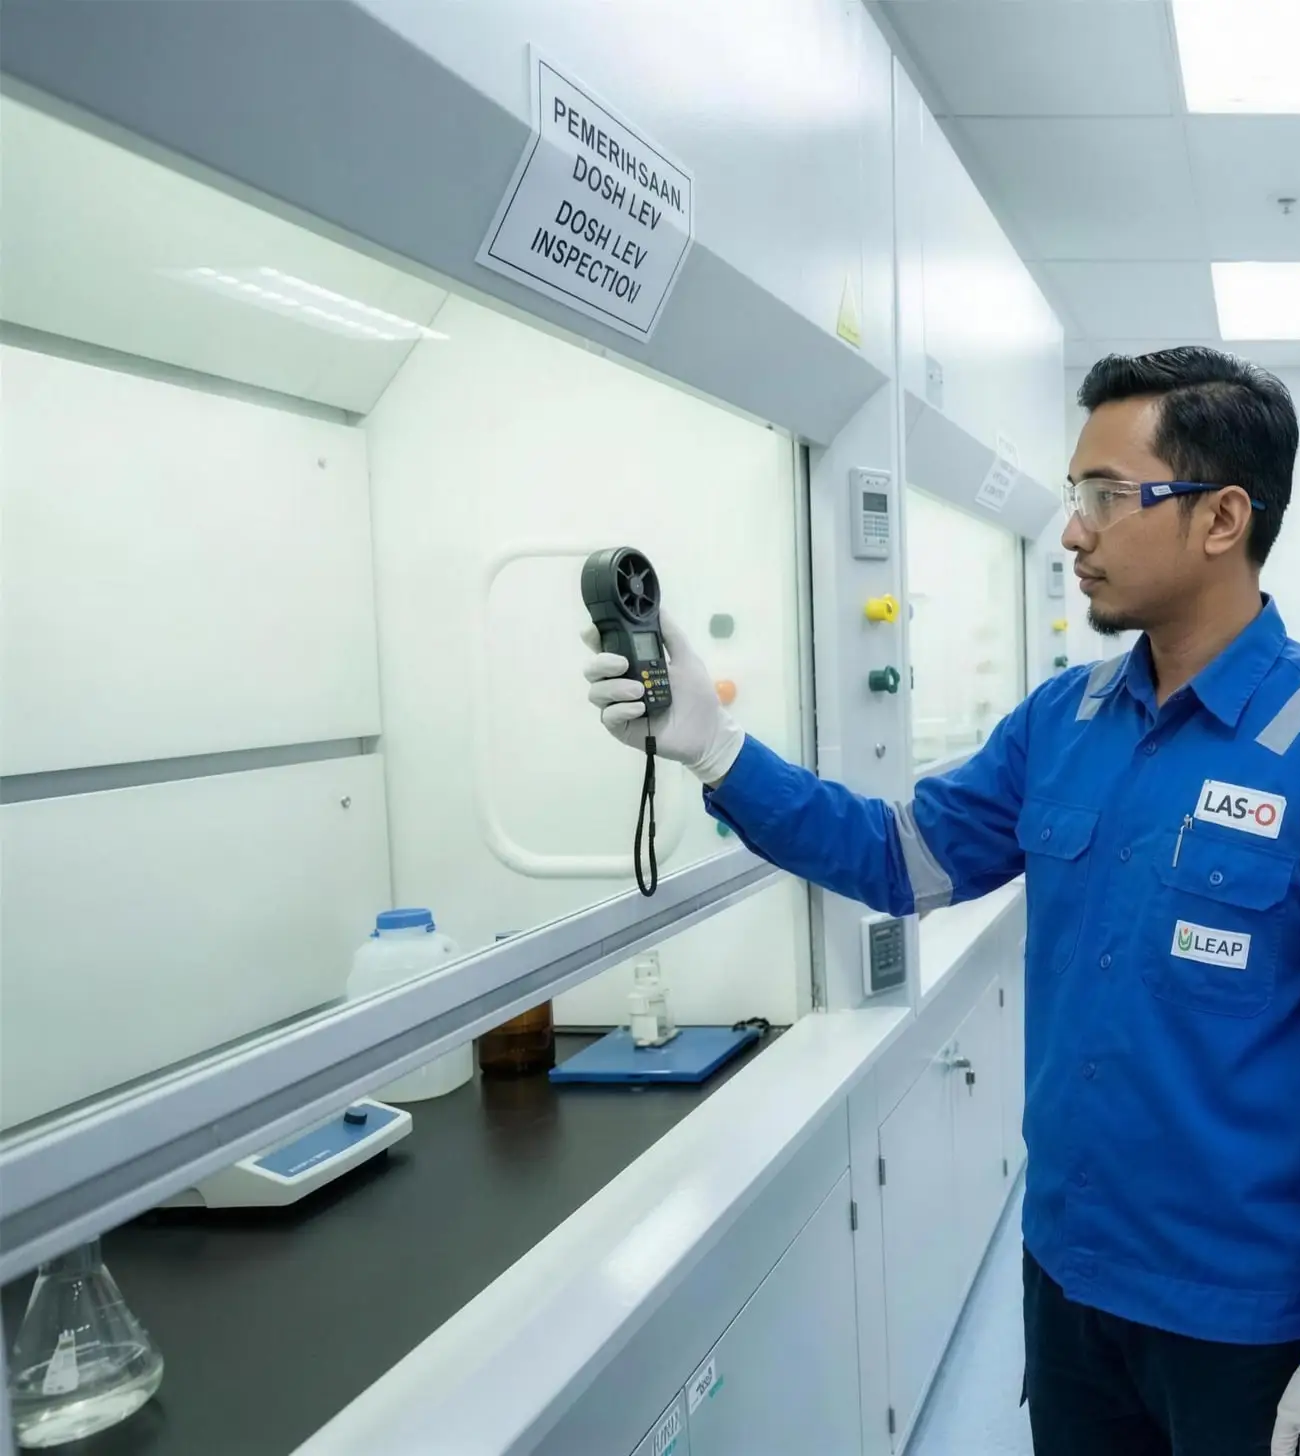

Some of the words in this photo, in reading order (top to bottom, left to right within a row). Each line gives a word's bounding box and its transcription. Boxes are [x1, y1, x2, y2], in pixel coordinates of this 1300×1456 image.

[572, 153, 627, 210] DOSH
[627, 192, 662, 231] LEV
[554, 199, 613, 251] DOSH
[610, 234, 649, 270] LEV
[1203, 790, 1276, 826] LAS-O
